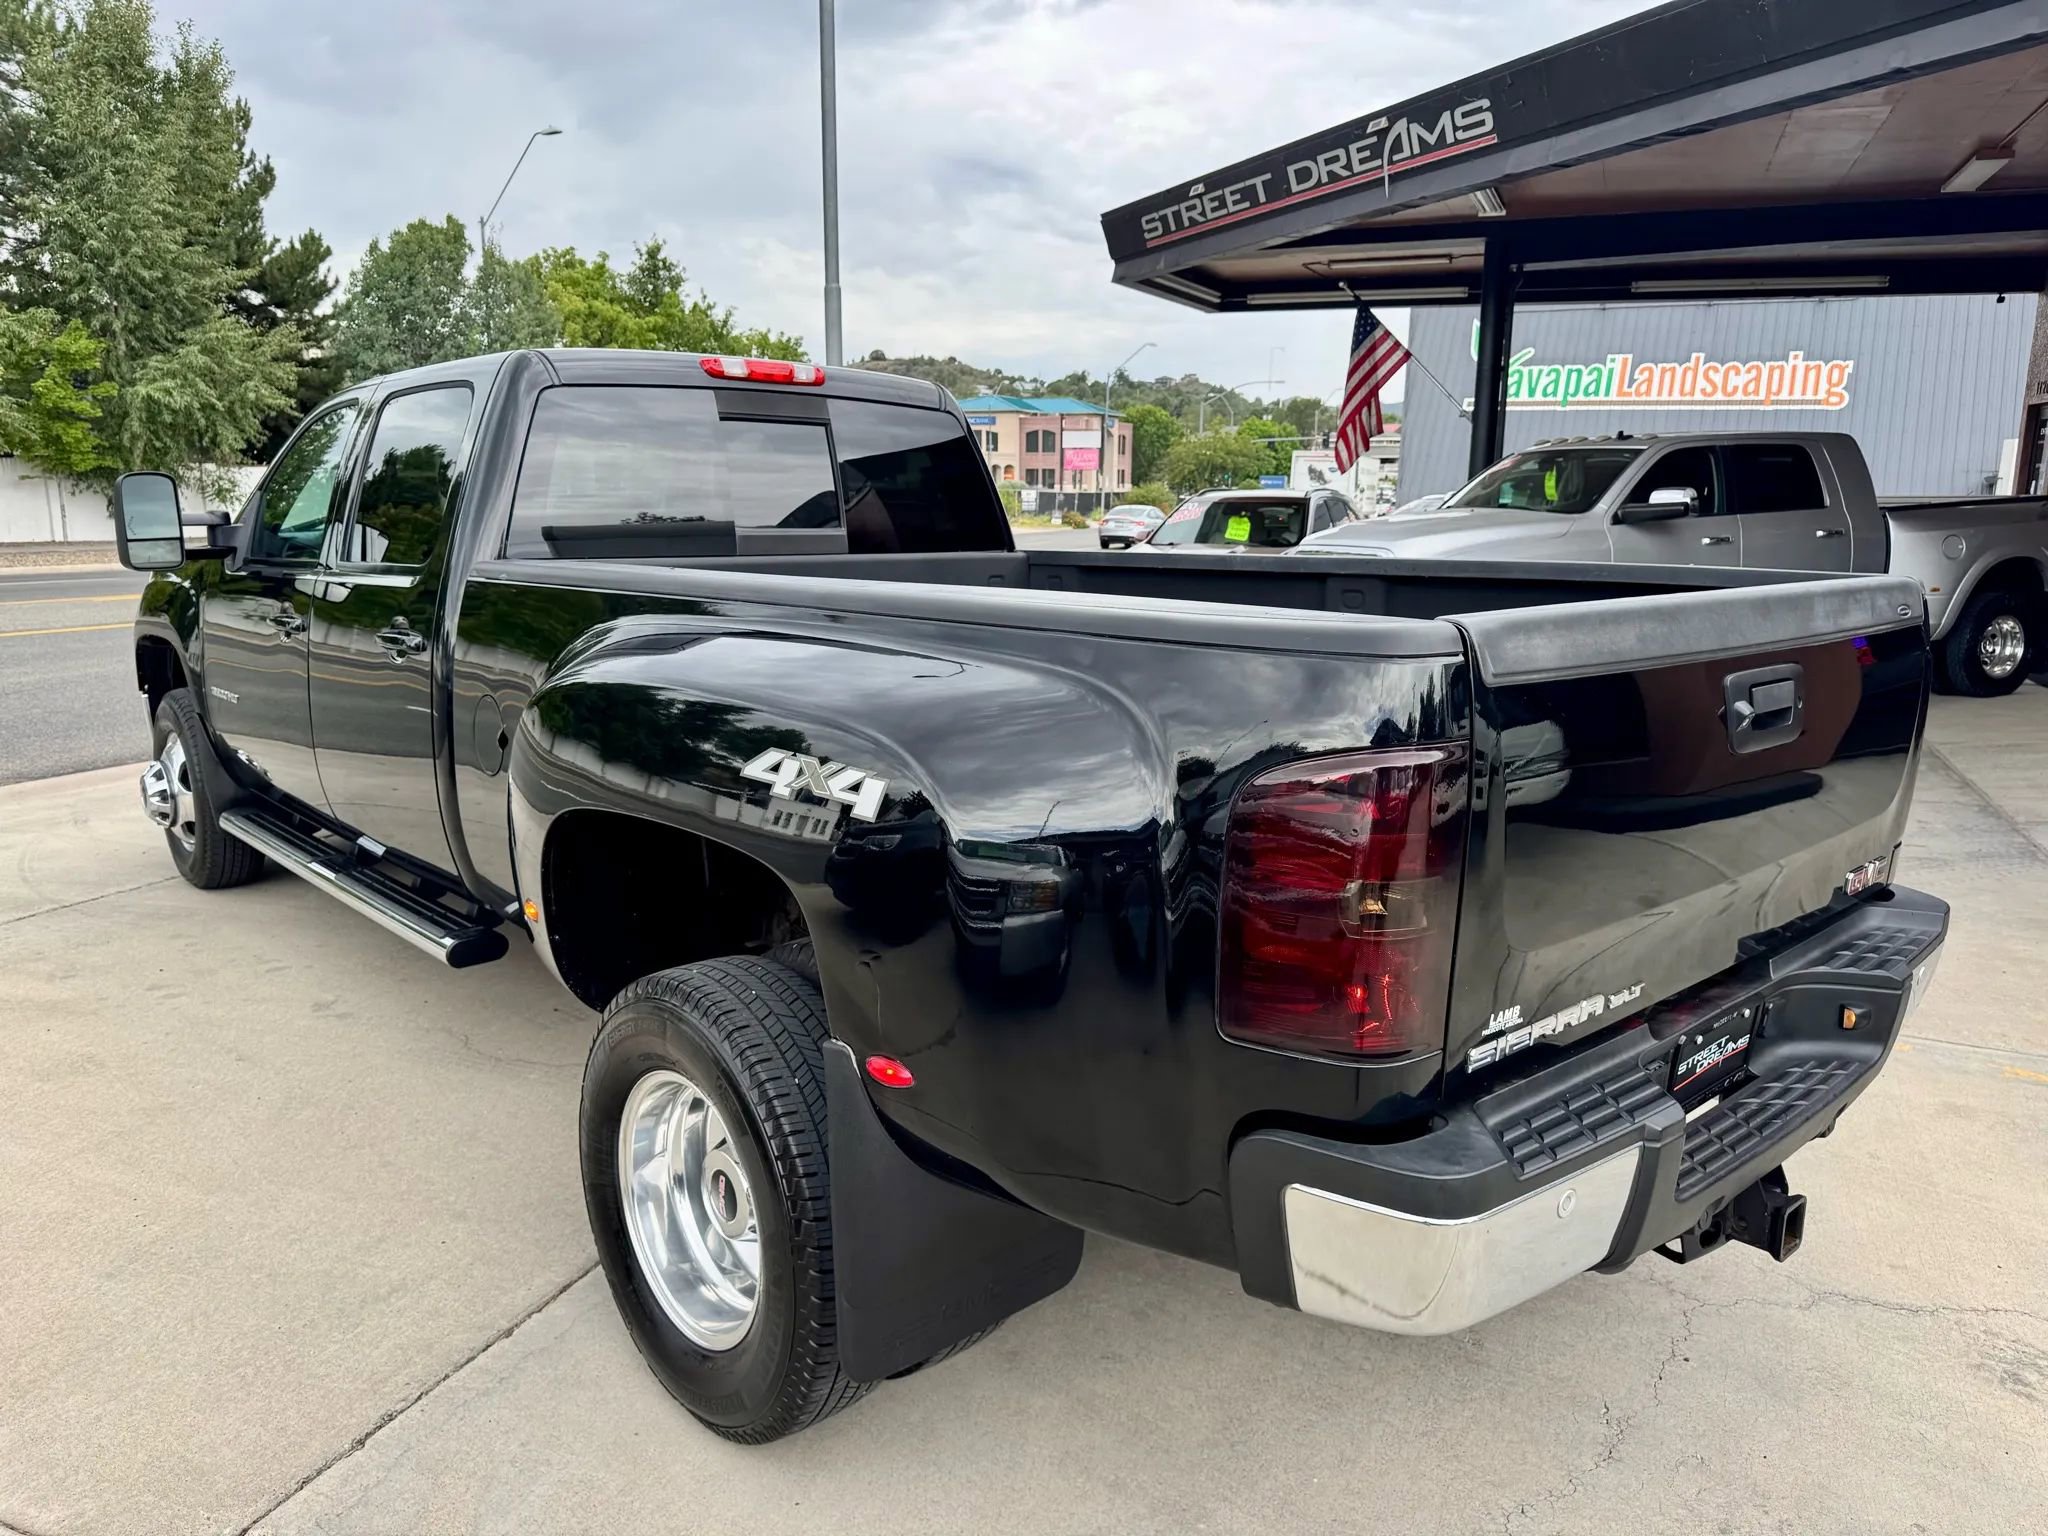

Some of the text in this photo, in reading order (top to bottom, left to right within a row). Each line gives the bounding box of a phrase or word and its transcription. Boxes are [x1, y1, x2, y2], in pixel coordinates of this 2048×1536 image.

[1141, 98, 1495, 240] STREET DREAMS
[1465, 994, 1605, 1073] SIERRA
[1489, 1005, 1521, 1026] LAMB
[1677, 1034, 1730, 1075] STREET
[1696, 1034, 1750, 1073] DREAMS
